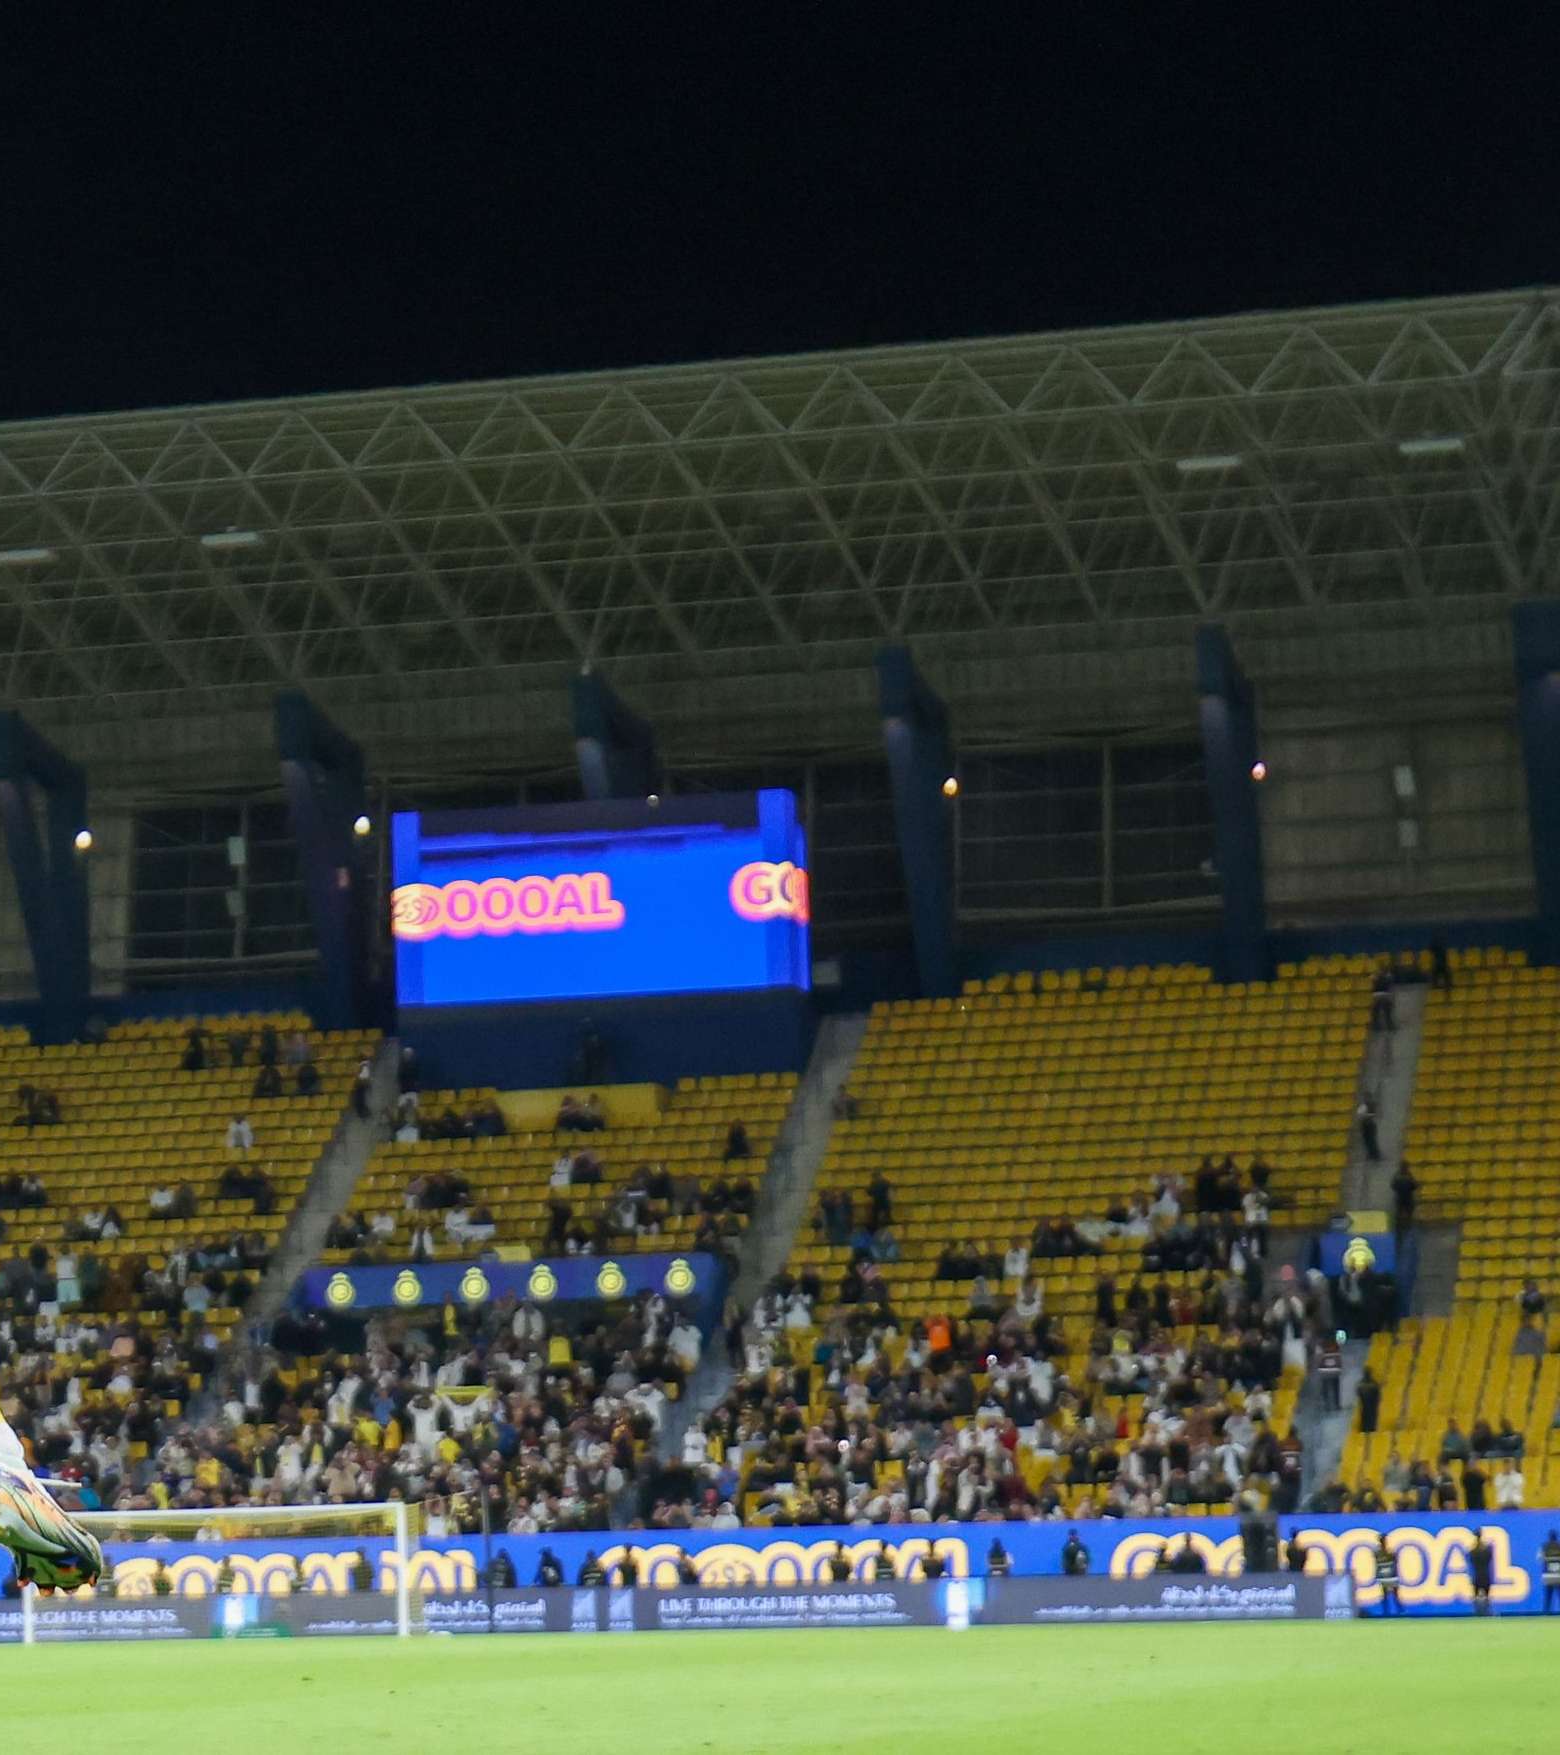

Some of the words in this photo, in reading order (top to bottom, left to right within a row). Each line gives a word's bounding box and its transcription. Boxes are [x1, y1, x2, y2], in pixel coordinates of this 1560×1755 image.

[659, 1598, 692, 1612] LIVE
[697, 1596, 778, 1612] THROUGH
[779, 1595, 809, 1609] THE
[811, 1593, 897, 1610] MOMENTS
[70, 1610, 98, 1623] THE
[100, 1608, 177, 1623] MOMENTS
